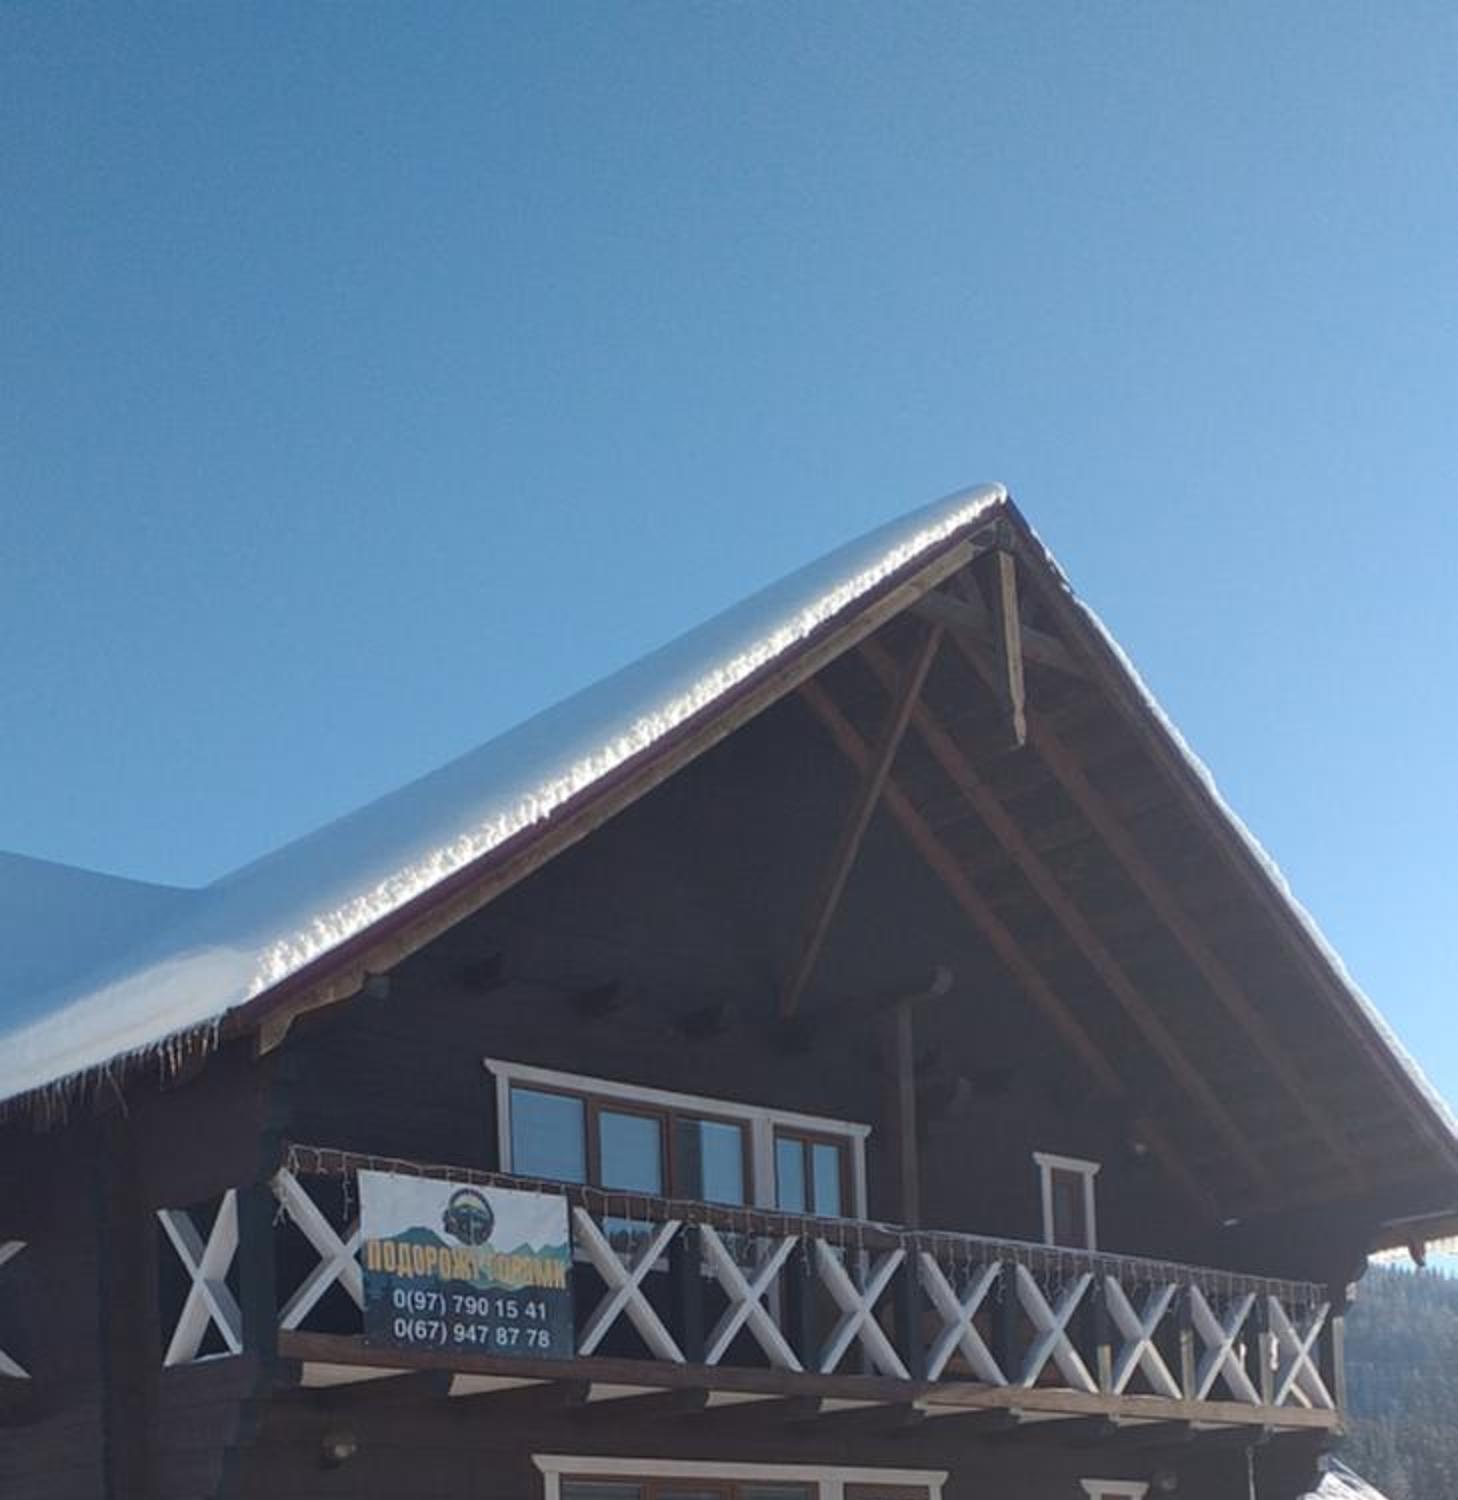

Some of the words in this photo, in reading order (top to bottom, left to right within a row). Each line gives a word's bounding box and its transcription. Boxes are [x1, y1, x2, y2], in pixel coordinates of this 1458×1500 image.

[393, 1289, 446, 1315] 0(97)
[452, 1296, 489, 1316] 790
[496, 1300, 518, 1318] 15
[524, 1302, 546, 1320] 41
[394, 1318, 447, 1344] 0(67)
[453, 1324, 489, 1343] 947
[496, 1327, 519, 1346] 87
[527, 1329, 550, 1348] 78
